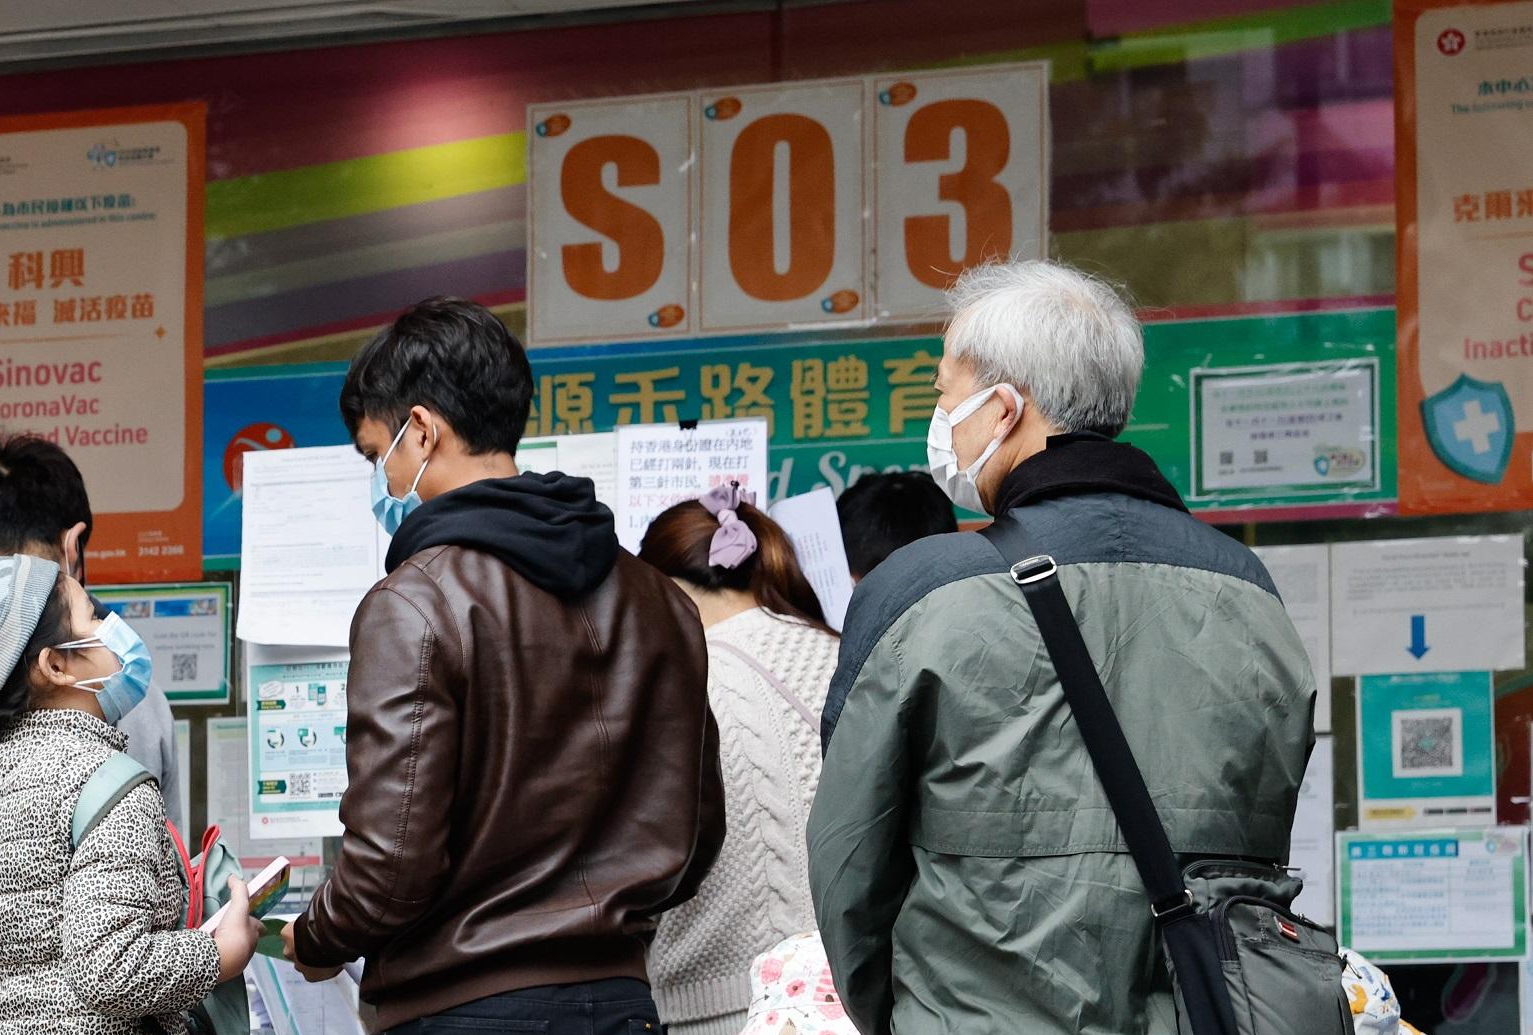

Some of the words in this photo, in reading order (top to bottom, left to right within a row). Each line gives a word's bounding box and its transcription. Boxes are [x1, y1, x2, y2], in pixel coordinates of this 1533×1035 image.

[561, 99, 1012, 301] S03
[8, 248, 85, 290] 科興
[53, 293, 155, 324] 滅活疫苗
[65, 424, 149, 448] Vaccine
